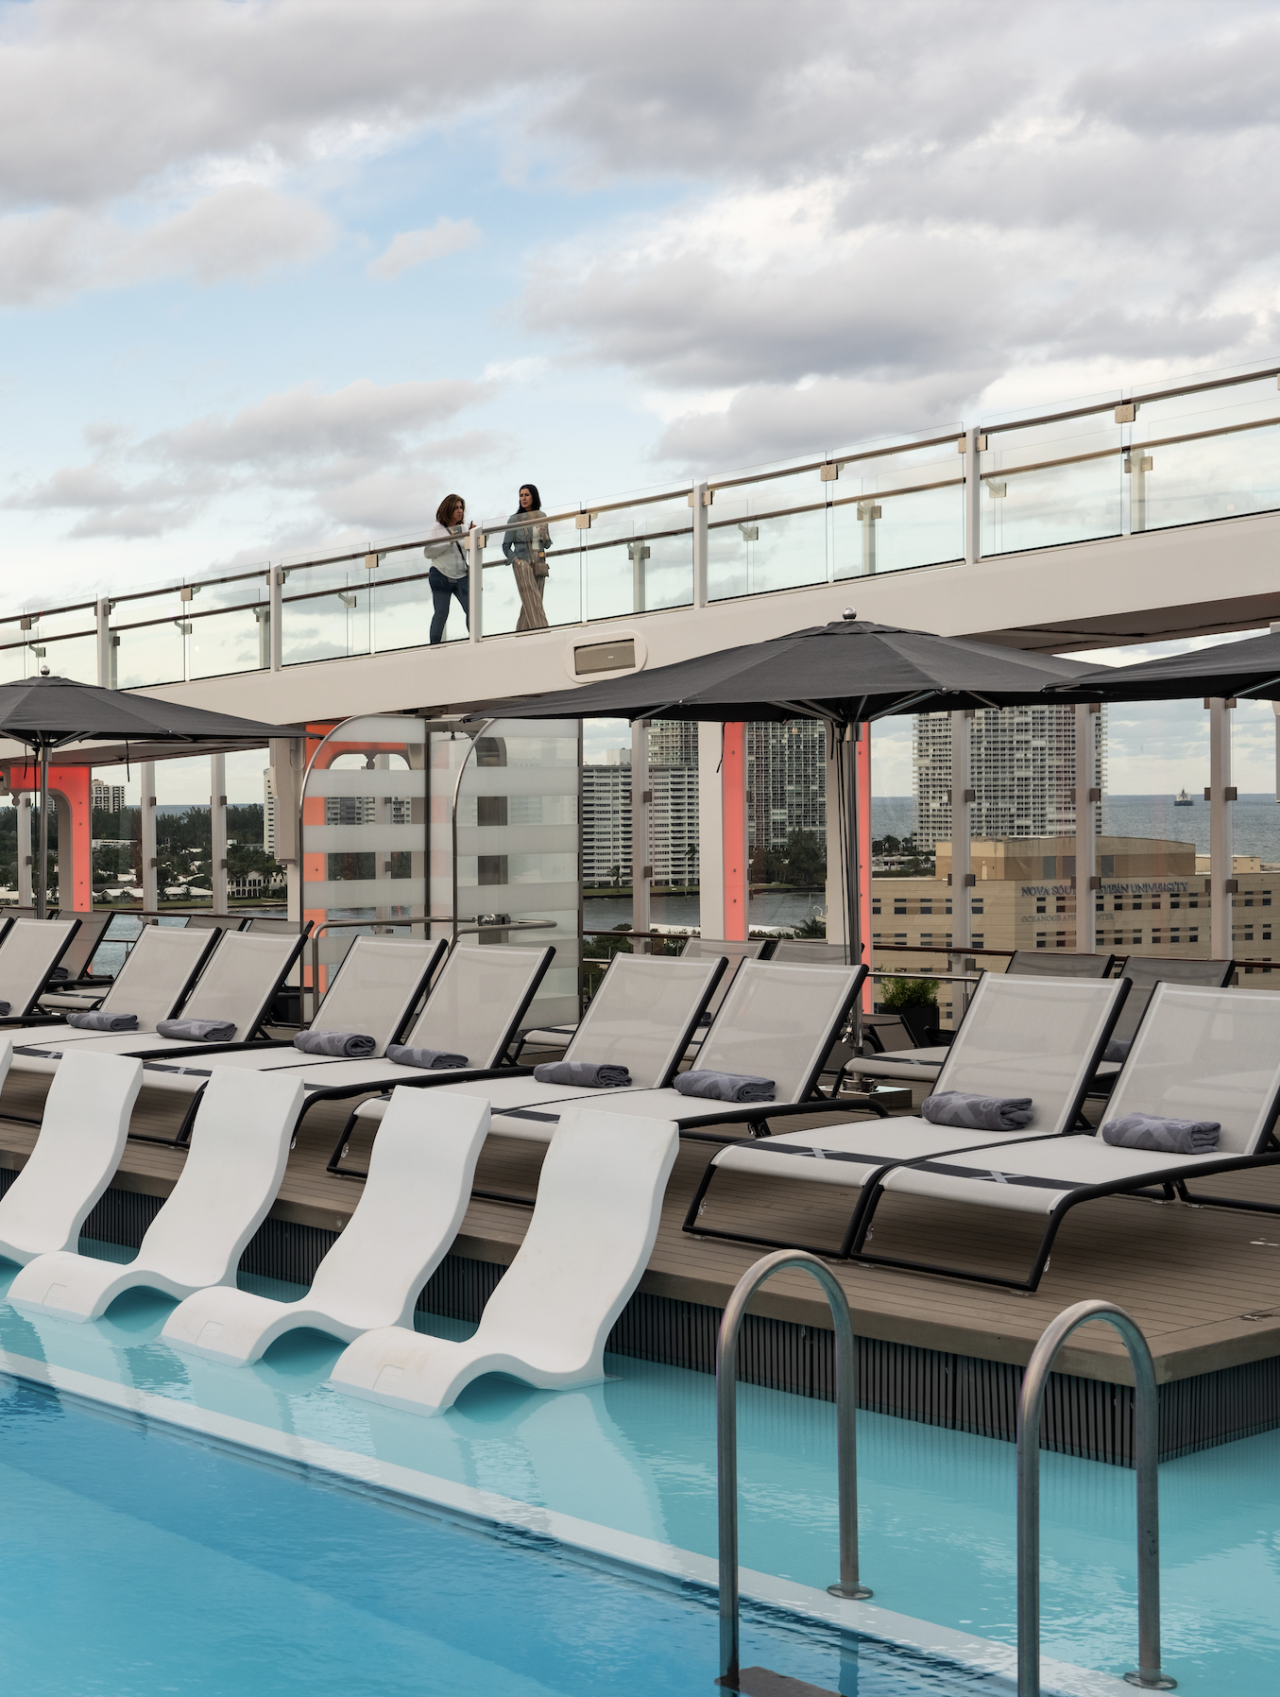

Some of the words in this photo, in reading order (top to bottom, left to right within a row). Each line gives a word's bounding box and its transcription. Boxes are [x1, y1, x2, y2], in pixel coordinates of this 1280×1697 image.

[1021, 886, 1050, 897] NOVA
[1052, 883, 1129, 896] SOUSTERN
[1130, 881, 1188, 893] UNIVERSITY
[1021, 913, 1076, 923] OCEANOGRAPH
